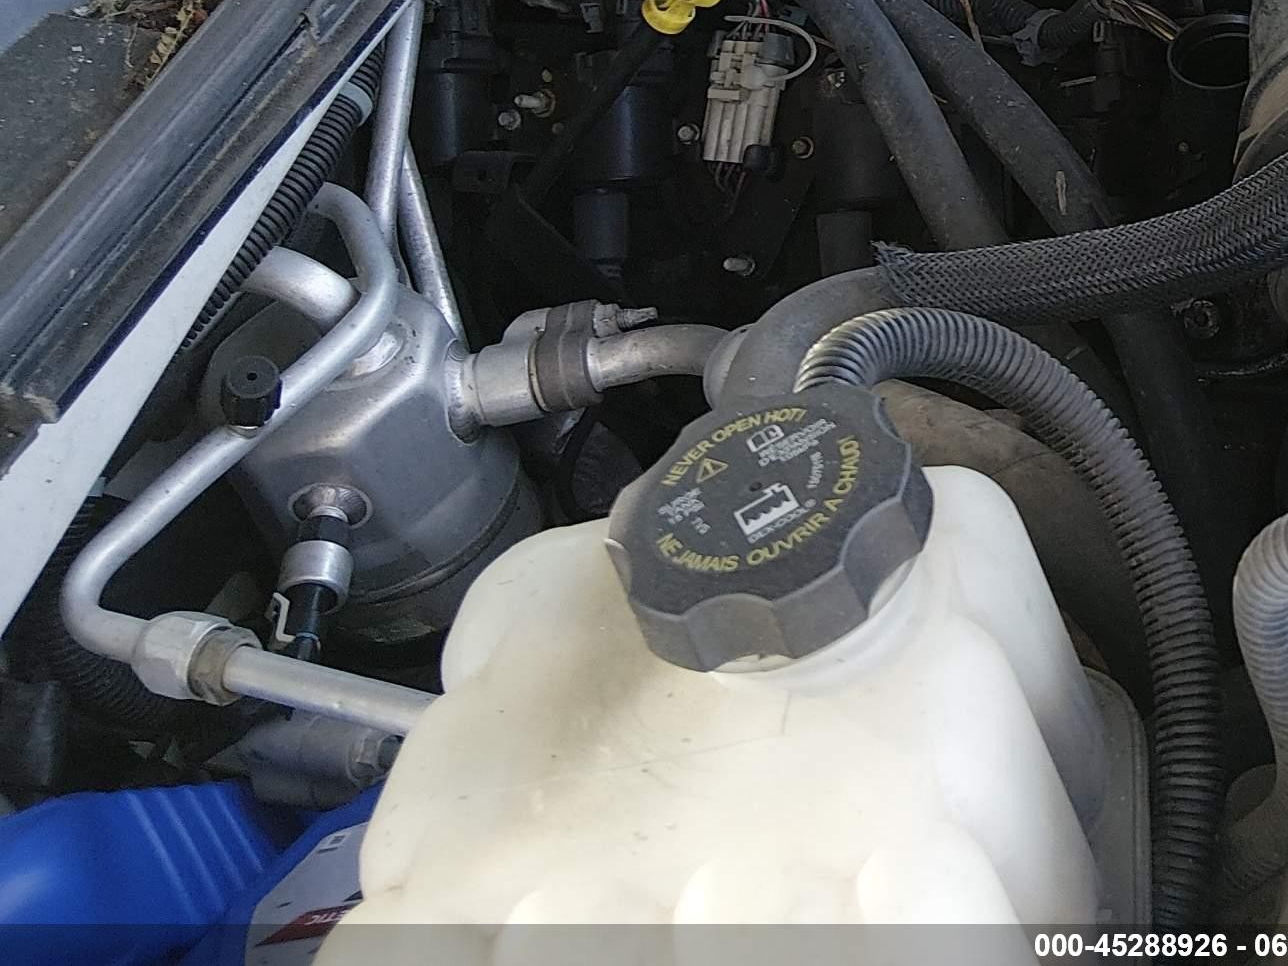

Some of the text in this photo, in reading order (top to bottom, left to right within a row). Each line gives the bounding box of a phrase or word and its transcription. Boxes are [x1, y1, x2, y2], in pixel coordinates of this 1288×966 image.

[660, 408, 808, 486] NEVER OPEN HOT!
[656, 533, 683, 557] NE
[672, 550, 739, 571] JAMAIS
[746, 513, 830, 565] OUVRIR
[832, 435, 860, 495] CHAUD!
